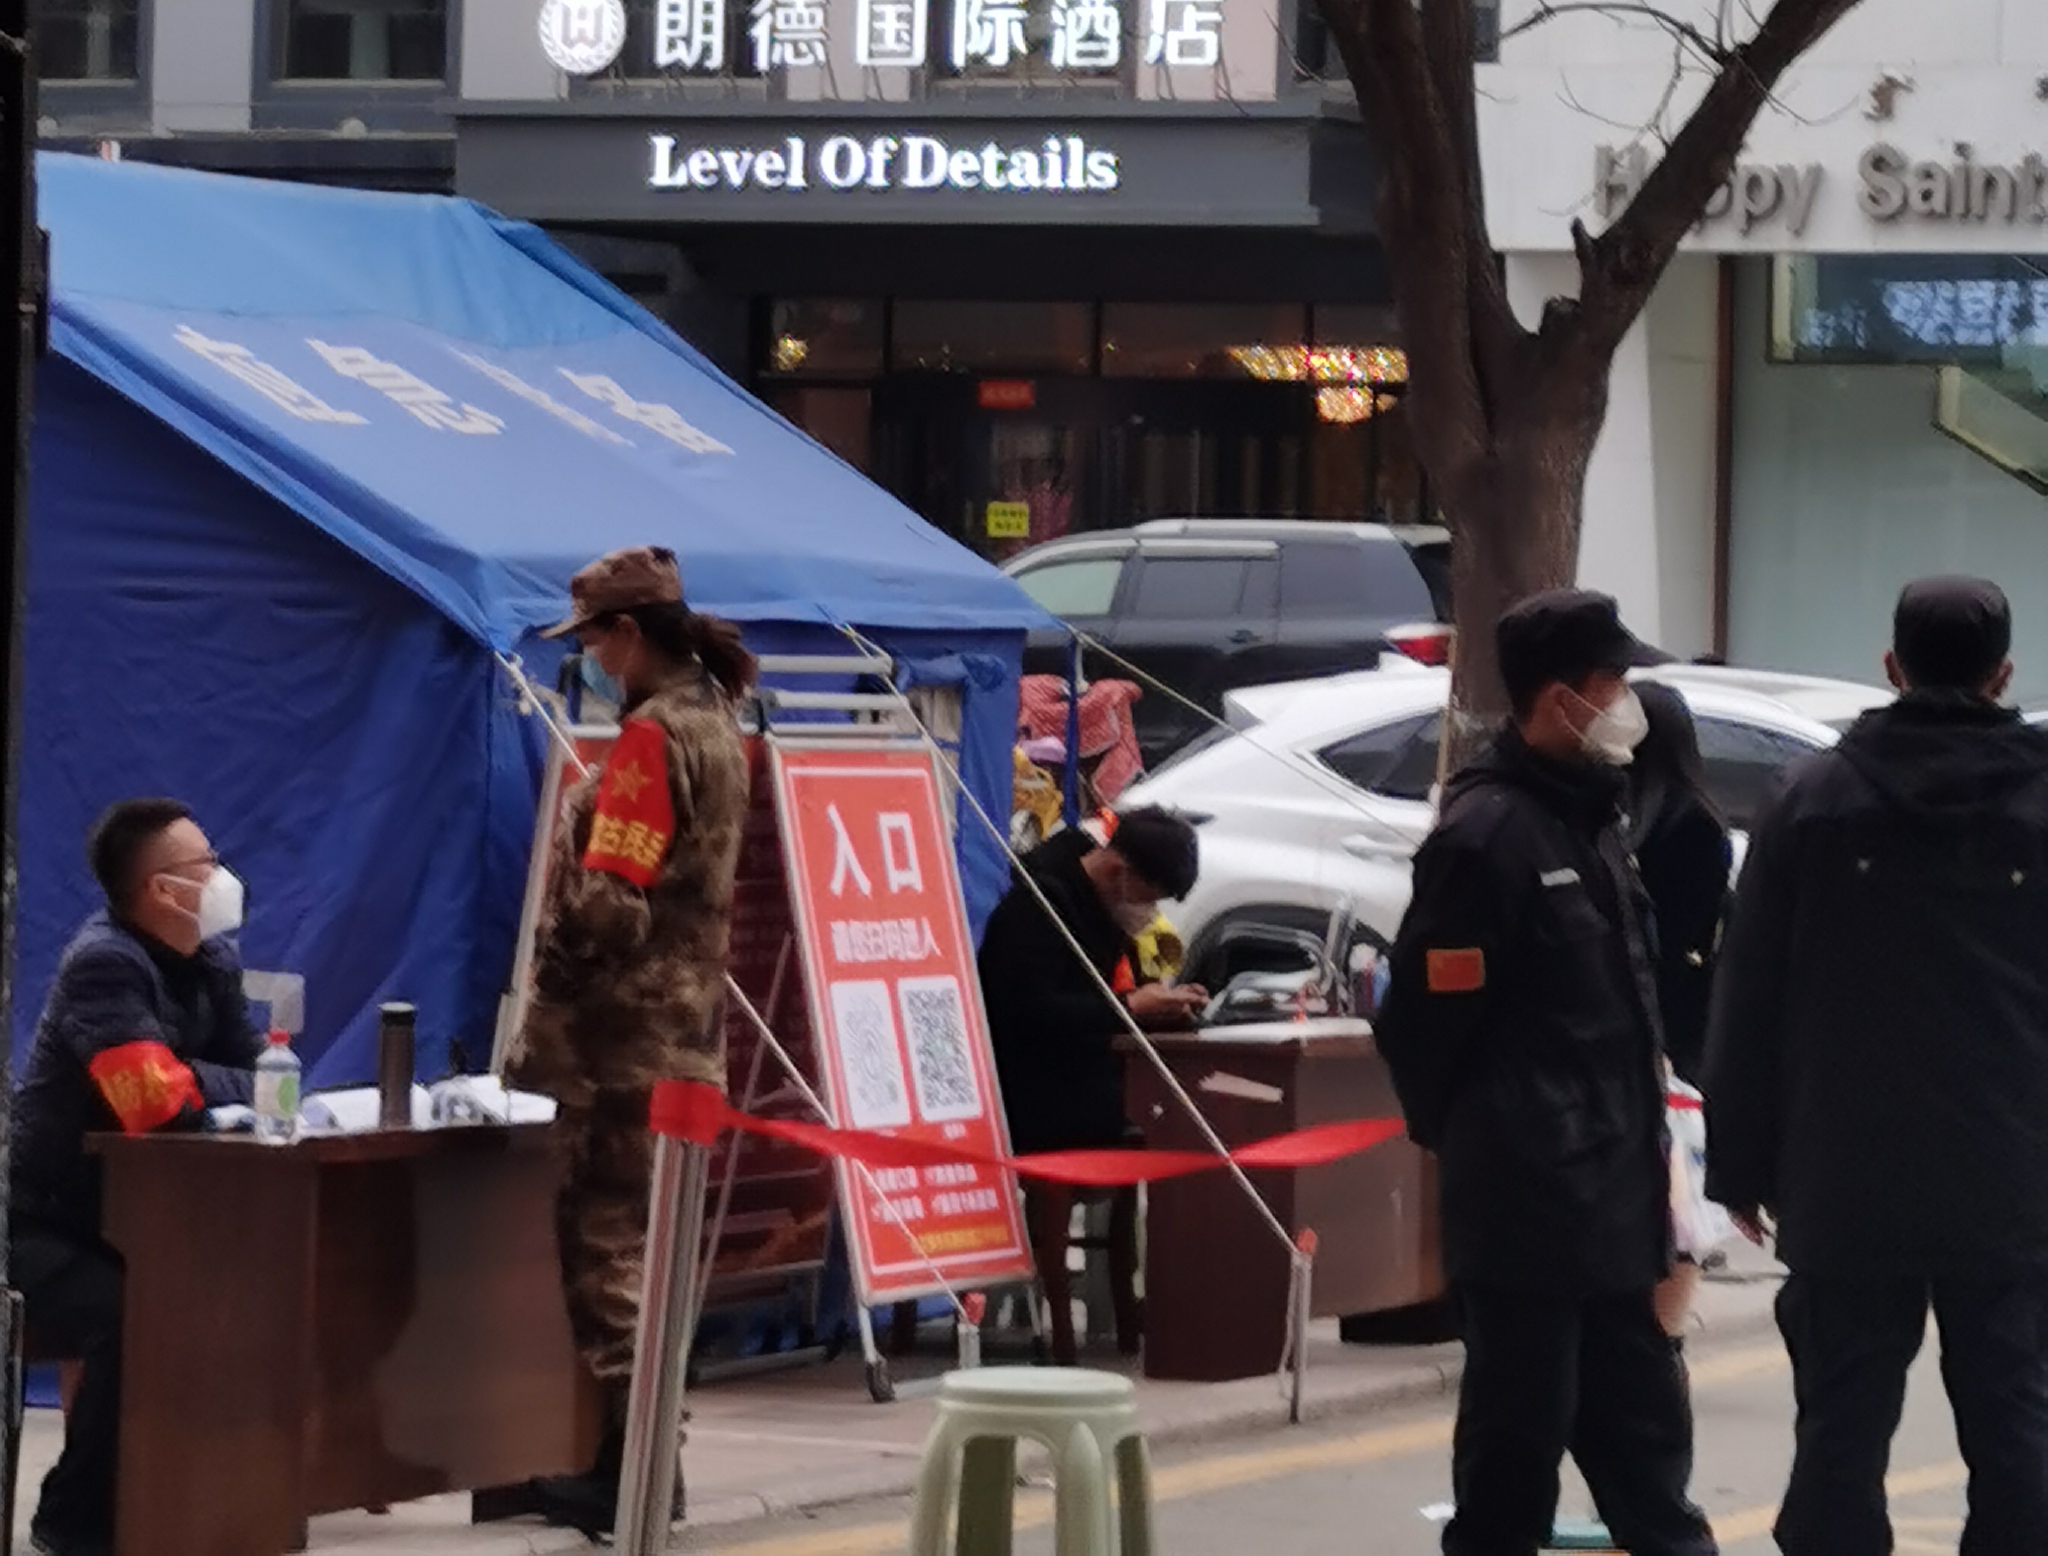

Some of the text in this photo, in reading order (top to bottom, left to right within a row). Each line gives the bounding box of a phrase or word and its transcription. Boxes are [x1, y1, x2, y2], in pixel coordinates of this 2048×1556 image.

[654, 0, 1224, 71] 朗德国际酒店
[648, 135, 1120, 190] Level Of Details
[829, 802, 924, 897] 入口
